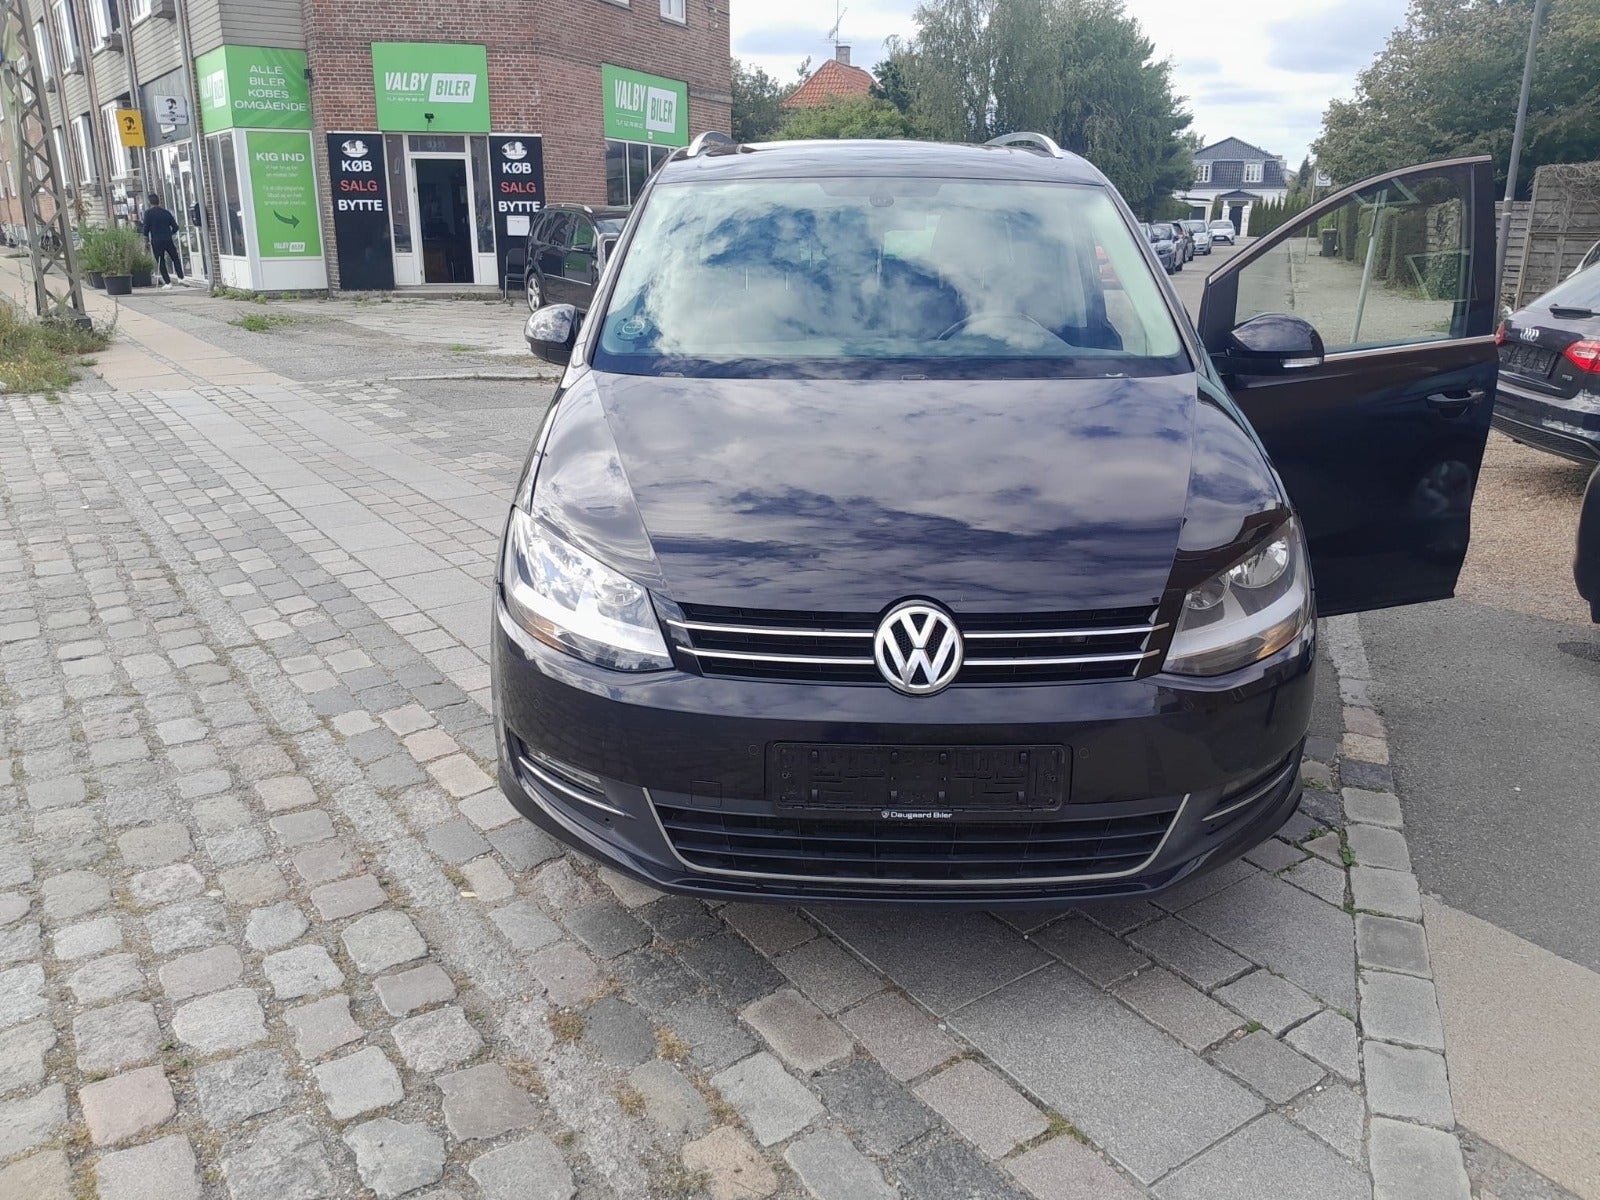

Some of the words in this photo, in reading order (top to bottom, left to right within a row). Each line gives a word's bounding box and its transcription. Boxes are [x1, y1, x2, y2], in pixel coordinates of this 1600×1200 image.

[249, 64, 283, 75] ALLE
[249, 76, 286, 87] BILER
[385, 72, 429, 92] VALBY
[435, 79, 471, 97] BILER
[235, 99, 307, 112] OMGÅENDE
[614, 79, 646, 112] VALBY
[650, 97, 673, 124] BILER
[256, 152, 278, 161] KIG
[282, 152, 305, 162] IND
[341, 159, 373, 172] KØB
[502, 162, 532, 174] KØB
[340, 179, 378, 192] SALG
[500, 181, 536, 193] SALG
[338, 199, 383, 211] BYTTE
[498, 200, 541, 213] BYTTE
[890, 811, 932, 820] Daugaard
[933, 811, 953, 819] Biler
